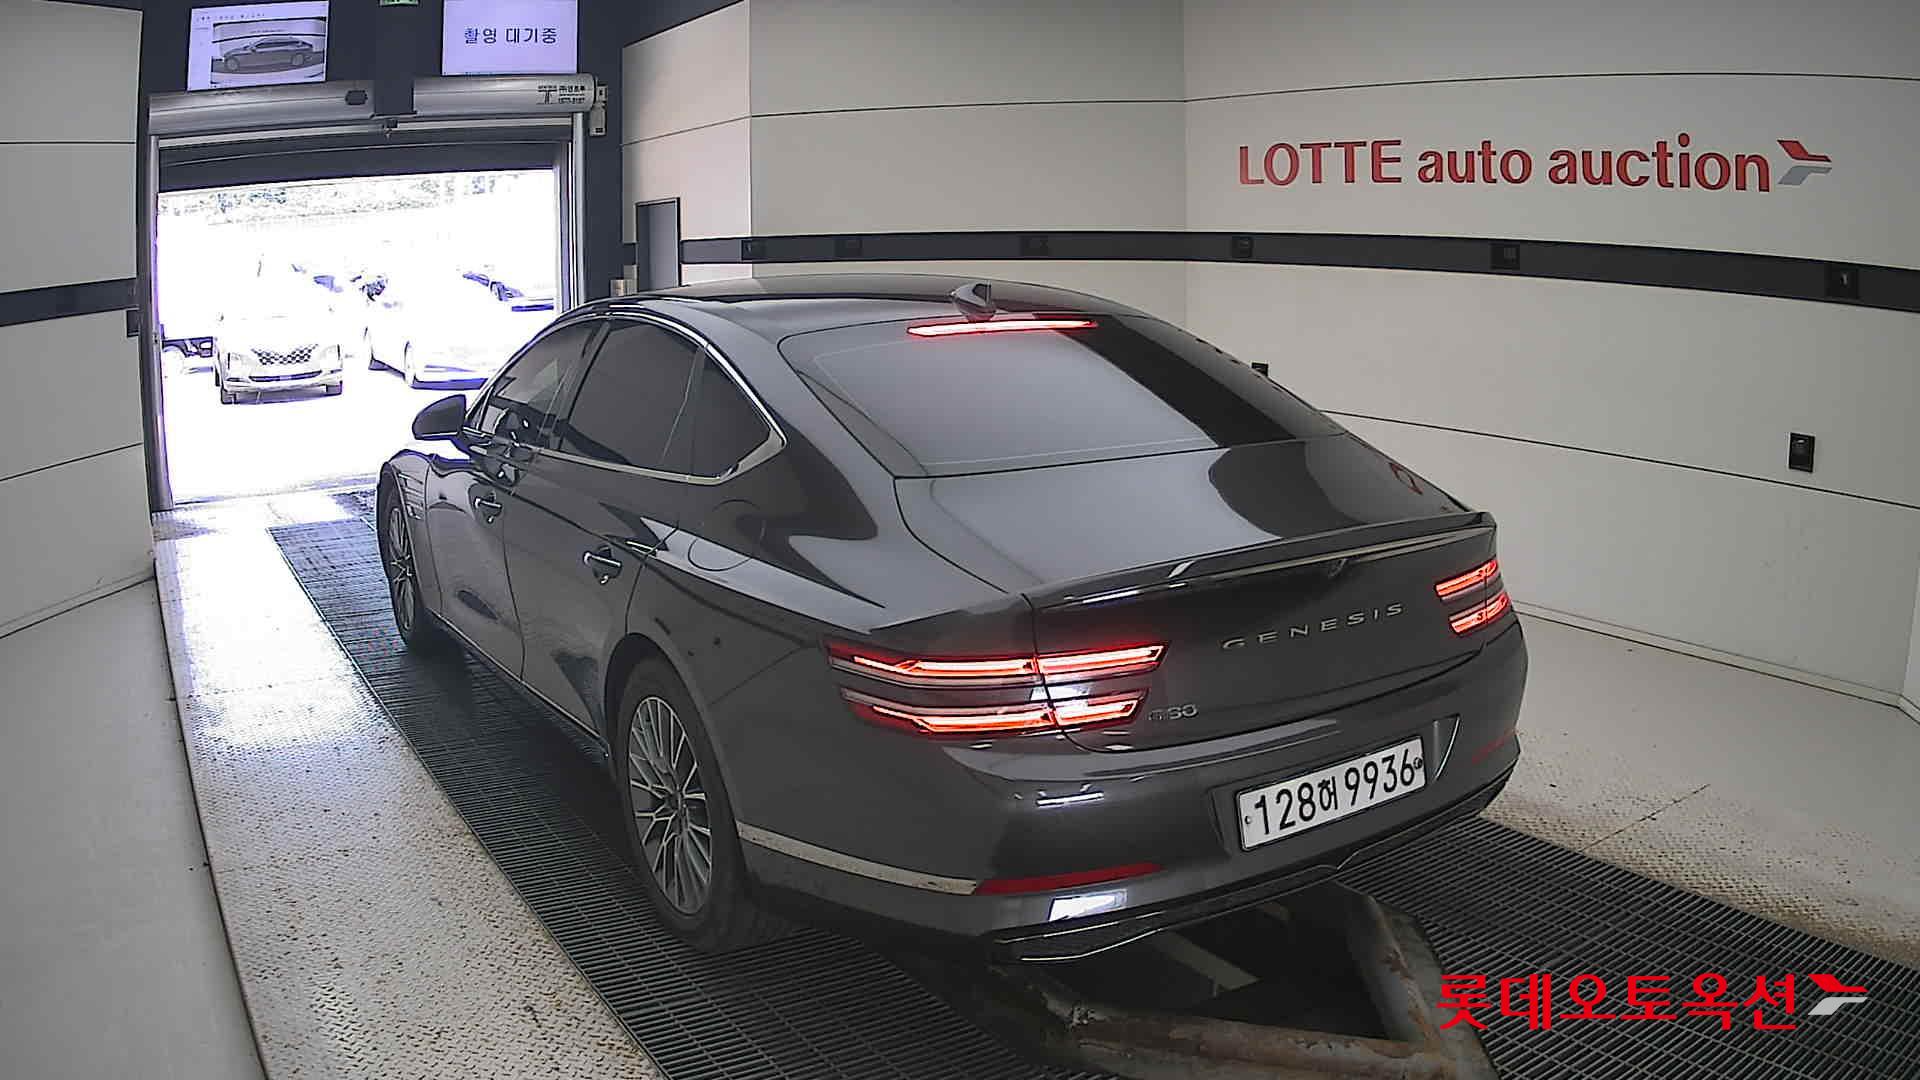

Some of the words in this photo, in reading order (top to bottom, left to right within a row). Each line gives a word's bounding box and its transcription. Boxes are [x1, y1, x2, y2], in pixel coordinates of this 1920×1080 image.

[464, 27, 498, 45] 촬영
[505, 26, 558, 45] 대기중
[1239, 140, 1402, 186] LOTTE
[1417, 141, 1533, 184] auto
[1549, 133, 1771, 193] auction
[1223, 603, 1404, 649] GENESIS
